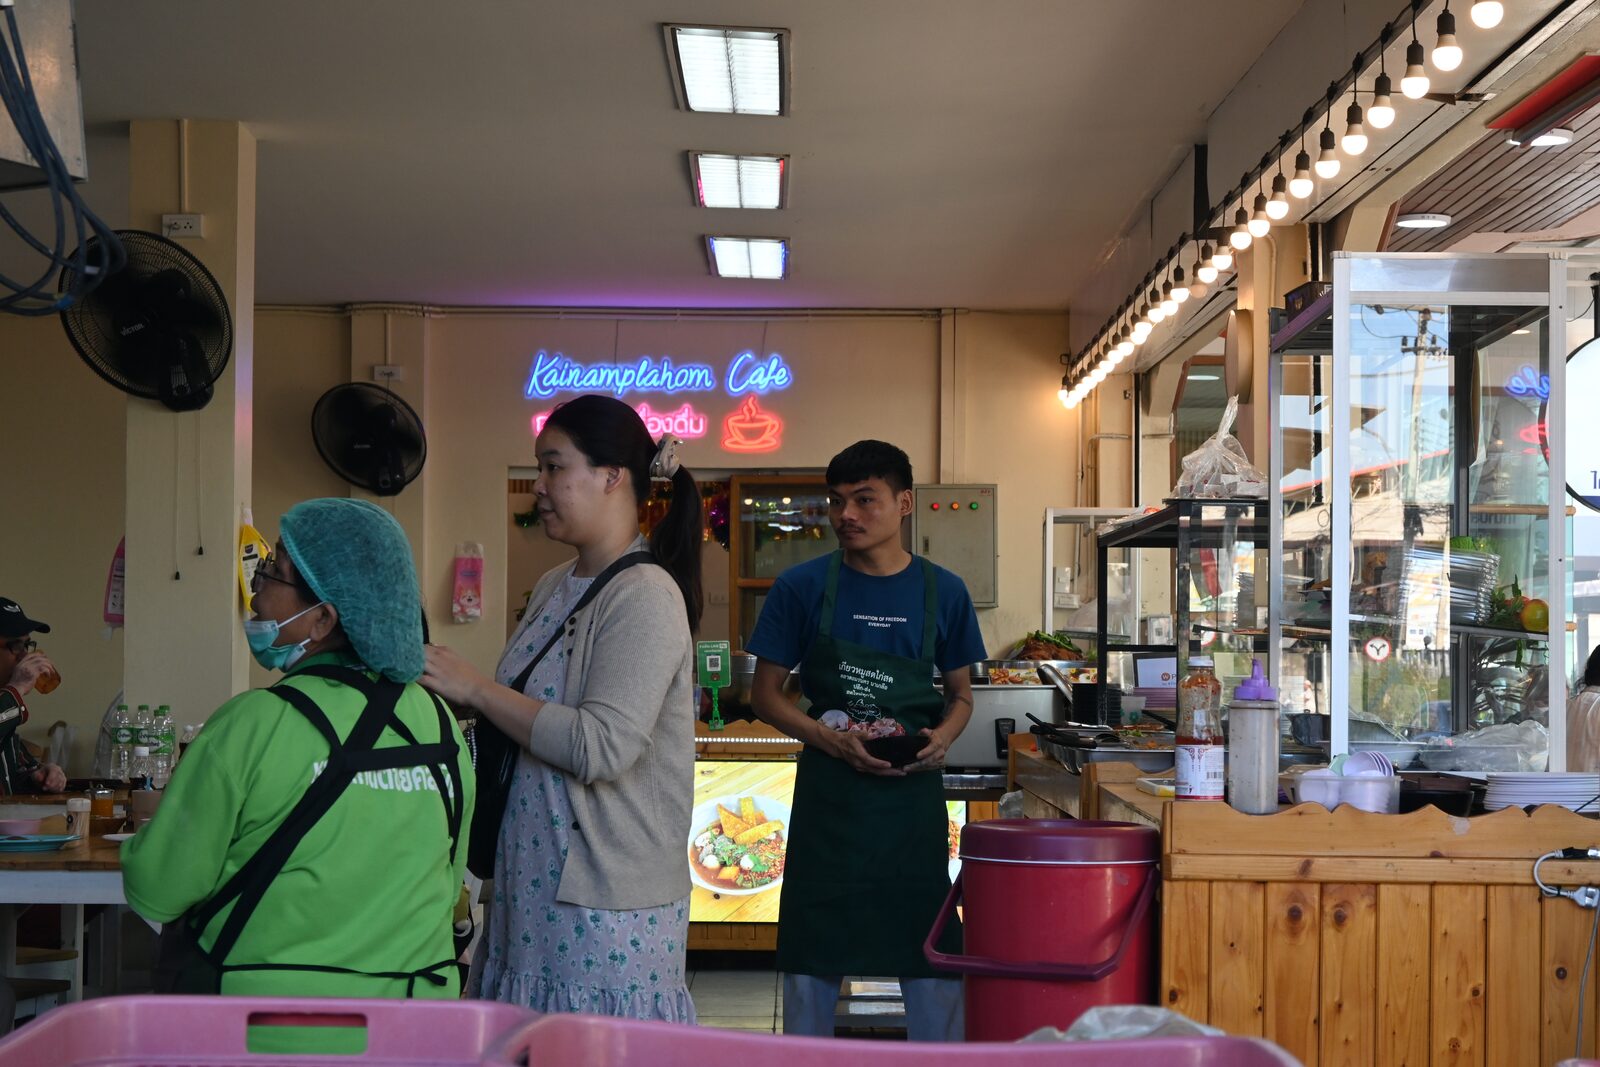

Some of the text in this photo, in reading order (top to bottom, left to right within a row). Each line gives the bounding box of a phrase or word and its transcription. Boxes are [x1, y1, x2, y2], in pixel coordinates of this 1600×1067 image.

[527, 352, 790, 397] Kainamplahom Cafe
[853, 614, 878, 622] SENSATION
